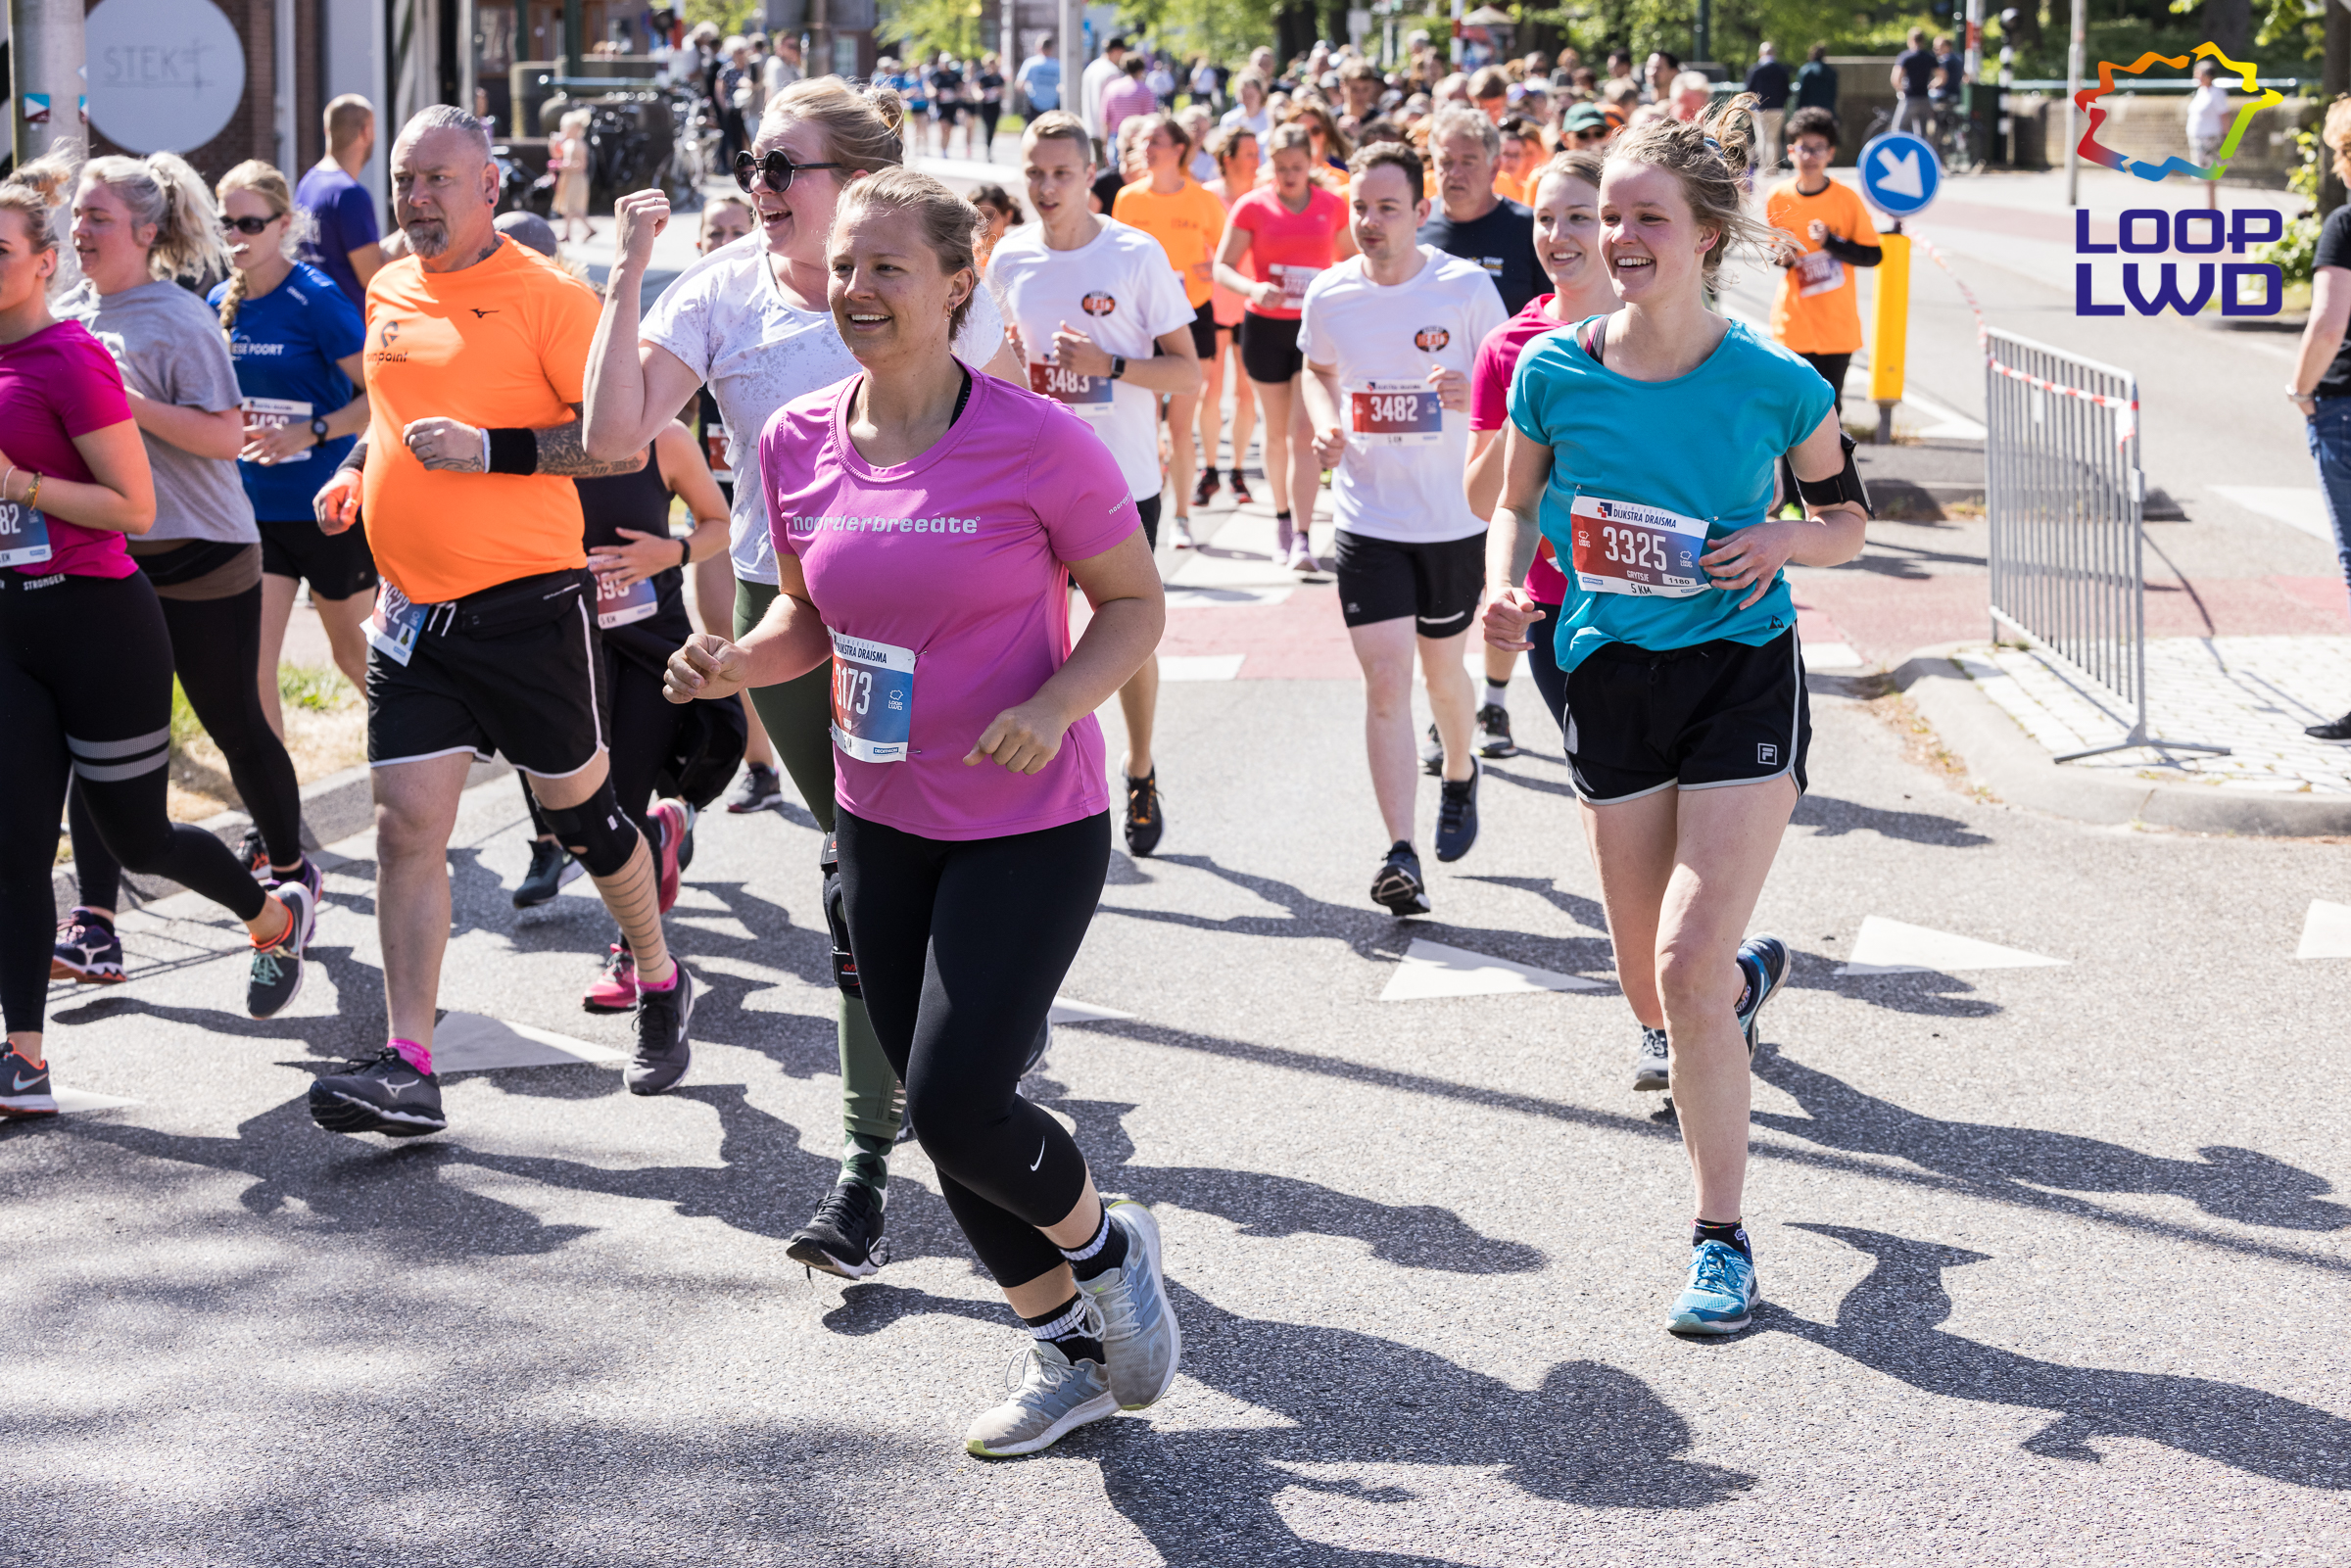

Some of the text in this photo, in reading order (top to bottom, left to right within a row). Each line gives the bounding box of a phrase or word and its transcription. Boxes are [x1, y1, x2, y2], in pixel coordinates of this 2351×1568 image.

[249, 344, 285, 356] POORT
[1369, 395, 1418, 422] 3482
[1613, 508, 1677, 529] DIJKSTRA DRAISMA
[1603, 526, 1667, 571] 3325
[23, 573, 66, 592] STRONGER
[1626, 570, 1650, 583] GRYTSJE
[1631, 583, 1653, 594] 5 KM
[857, 647, 888, 664] DRAISMA
[836, 662, 873, 715] 3173
